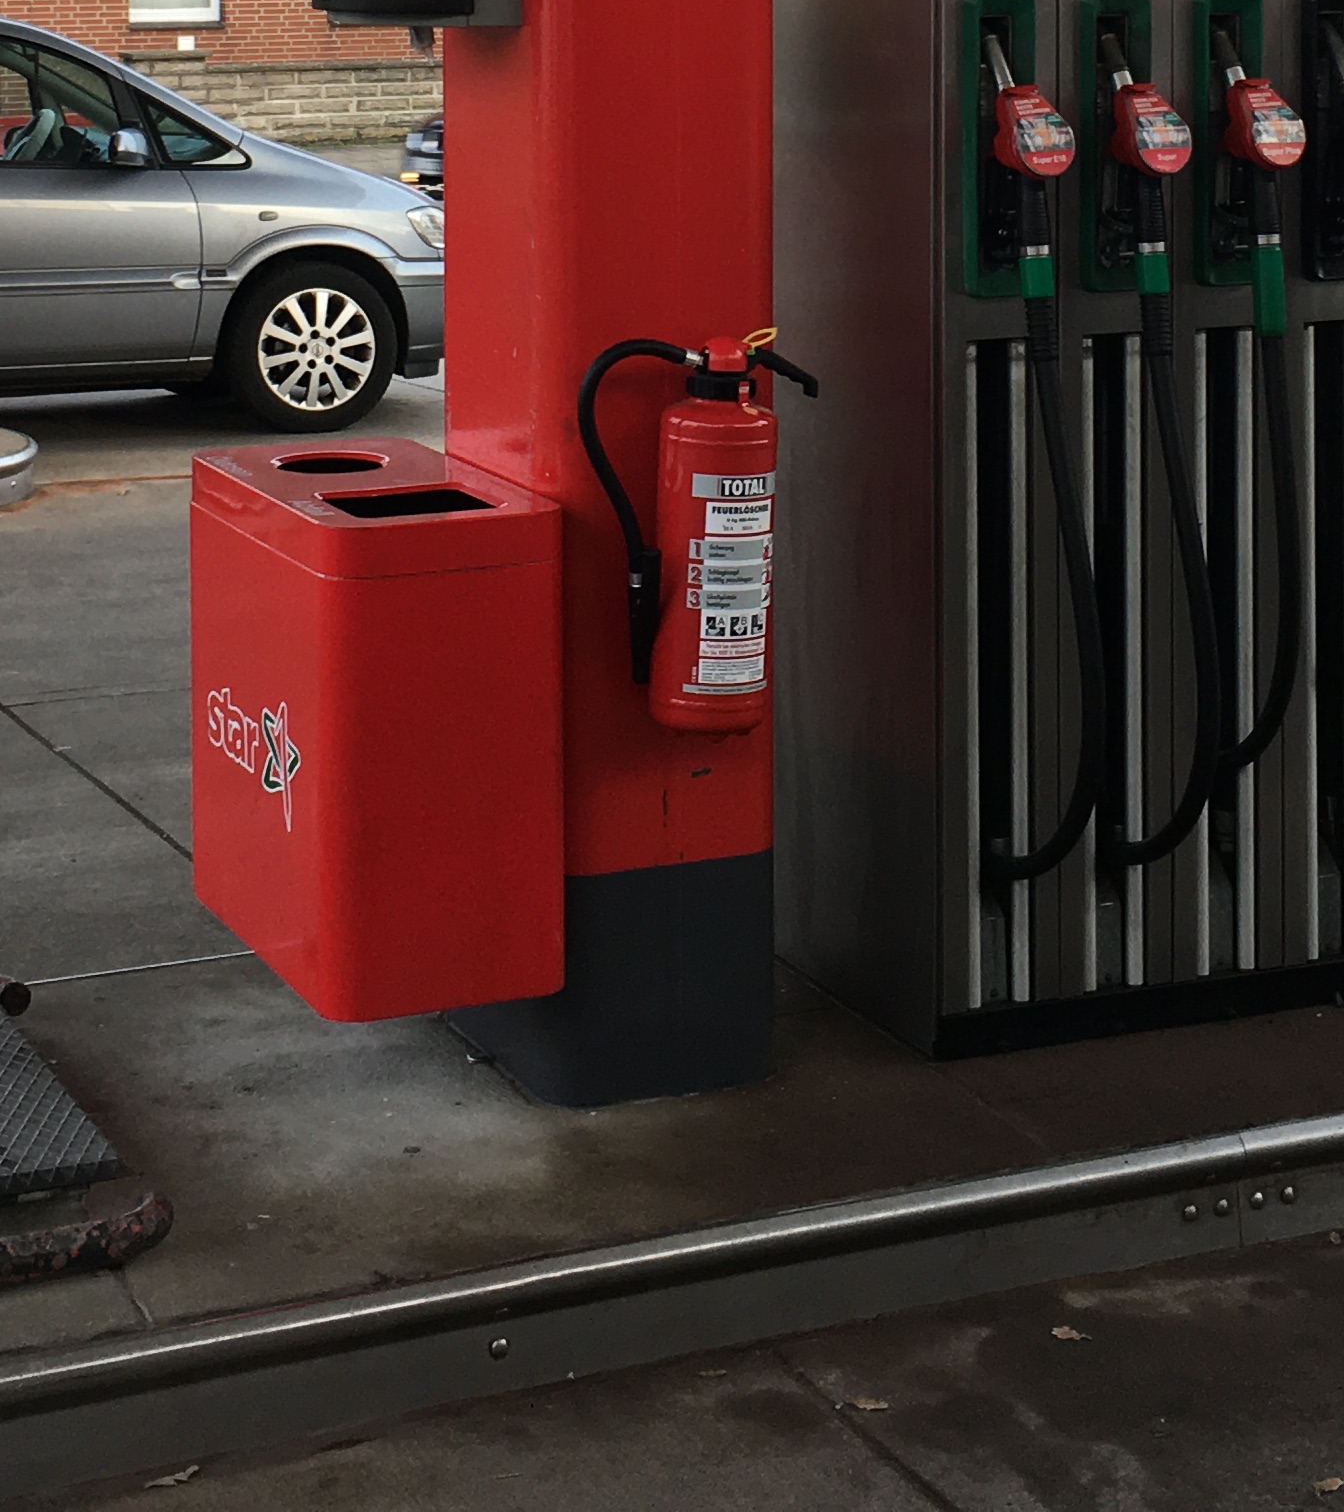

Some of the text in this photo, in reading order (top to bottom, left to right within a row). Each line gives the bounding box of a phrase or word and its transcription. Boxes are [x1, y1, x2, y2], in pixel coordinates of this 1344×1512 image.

[1032, 156, 1053, 165] Super
[722, 478, 765, 496] TOTAL
[690, 566, 702, 583] 2
[689, 590, 701, 607] 3
[717, 616, 726, 626] A
[741, 616, 747, 625] B
[207, 686, 259, 773] star
